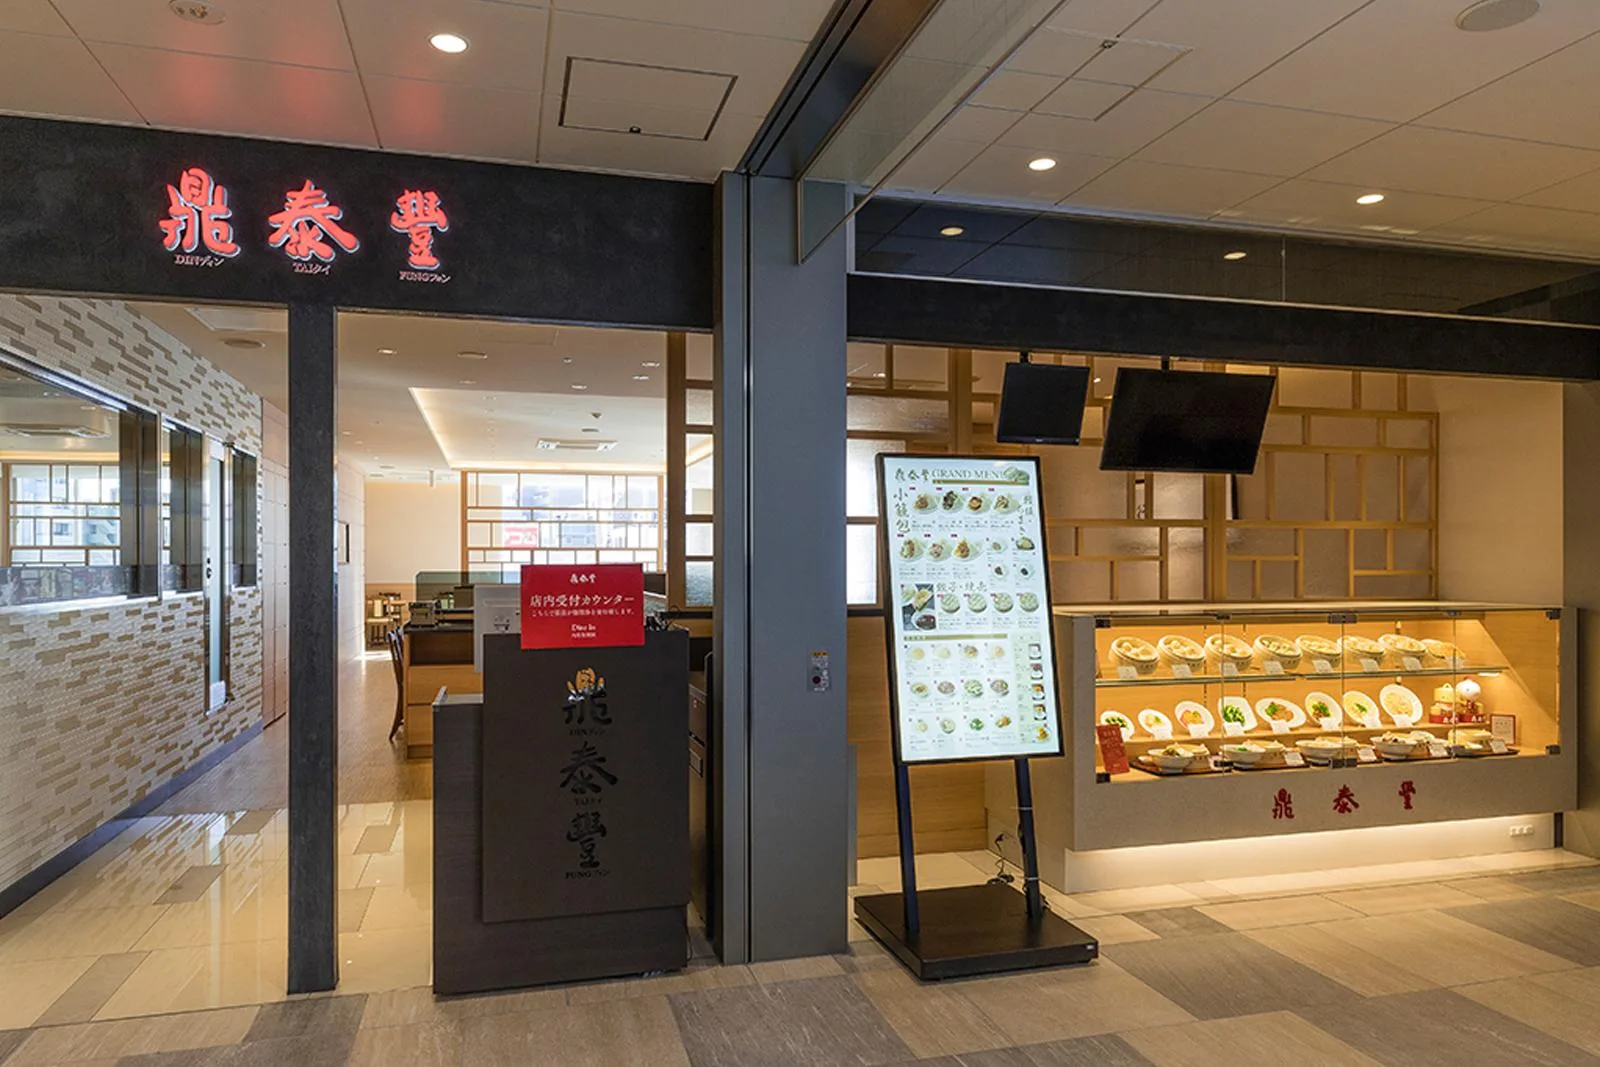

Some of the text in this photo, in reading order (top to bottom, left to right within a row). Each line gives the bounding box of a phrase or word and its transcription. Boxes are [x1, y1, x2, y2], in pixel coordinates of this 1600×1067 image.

[931, 468, 973, 480] GRAND
[530, 594, 635, 608] 店内受付カウンター
